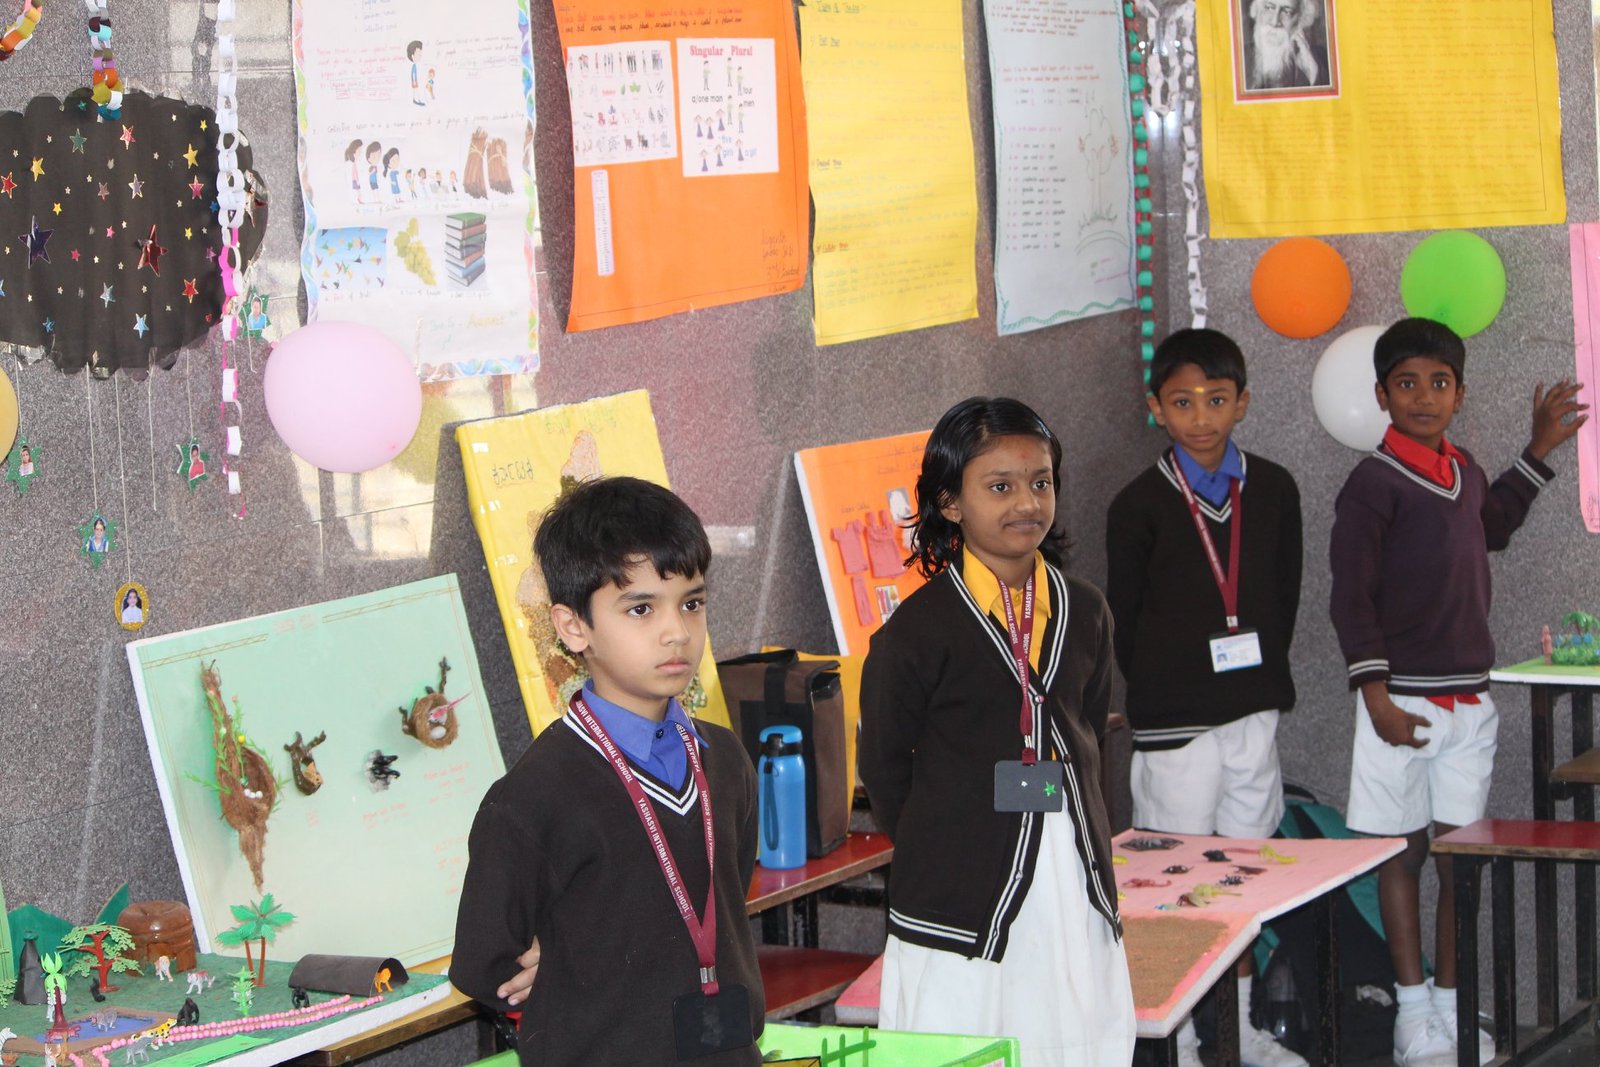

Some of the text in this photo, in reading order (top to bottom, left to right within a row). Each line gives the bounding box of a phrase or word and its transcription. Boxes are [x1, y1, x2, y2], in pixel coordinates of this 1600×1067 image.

[690, 45, 753, 58] Singular Plural
[1024, 590, 1032, 619] YASHASVI
[1009, 622, 1018, 645] SCHOOL
[584, 714, 619, 759] INTERNATIONAL
[614, 757, 634, 784] SCHOOL
[684, 741, 701, 773] YASHASVI
[701, 790, 711, 817] SCHOOL
[637, 798, 690, 913] YASHASVI INTERNATIONAL SCHOOL
